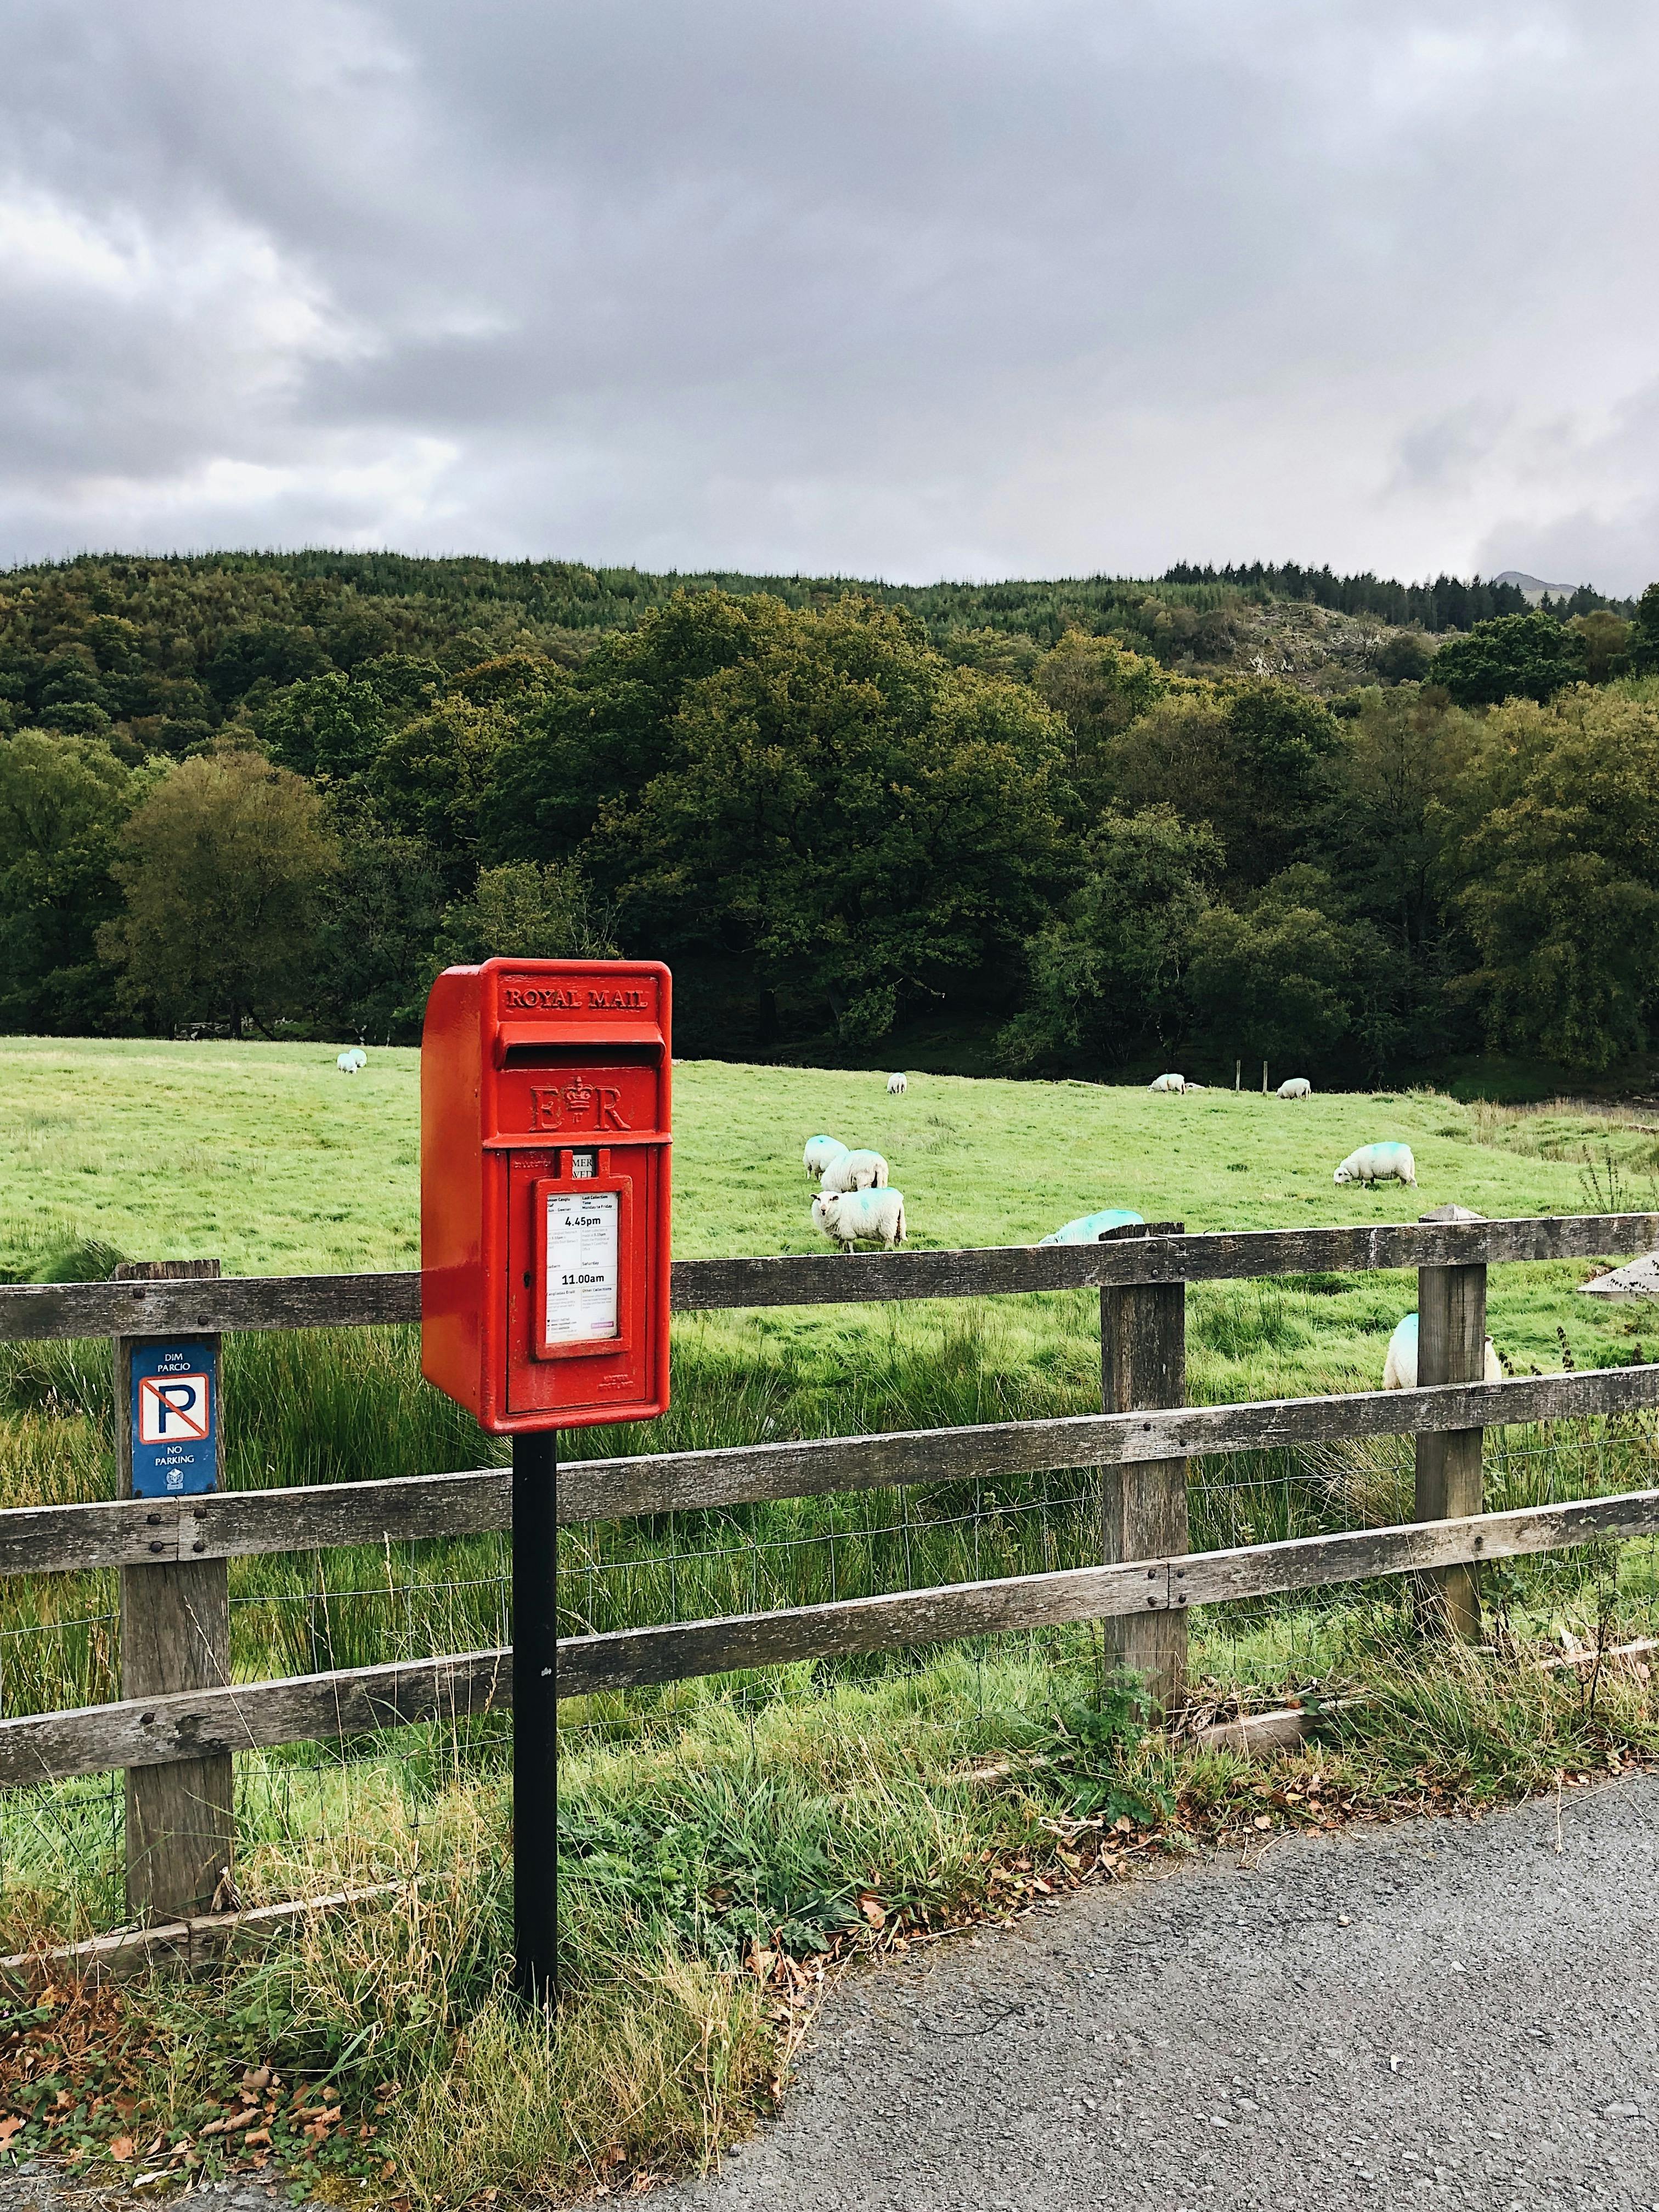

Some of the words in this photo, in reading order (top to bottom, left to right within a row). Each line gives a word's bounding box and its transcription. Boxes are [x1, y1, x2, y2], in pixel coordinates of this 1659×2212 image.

[506, 989, 582, 1008] ROYAL
[588, 990, 648, 1008] MAIL
[529, 1086, 563, 1131] E
[594, 1085, 631, 1131] R
[565, 1216, 601, 1227] 4.45pm
[562, 1274, 604, 1285] 11.00am
[165, 1353, 183, 1362] DIM
[157, 1363, 190, 1372] PARCIO
[159, 1384, 196, 1434] P
[167, 1446, 183, 1454] NO
[155, 1455, 195, 1466] PARKING
